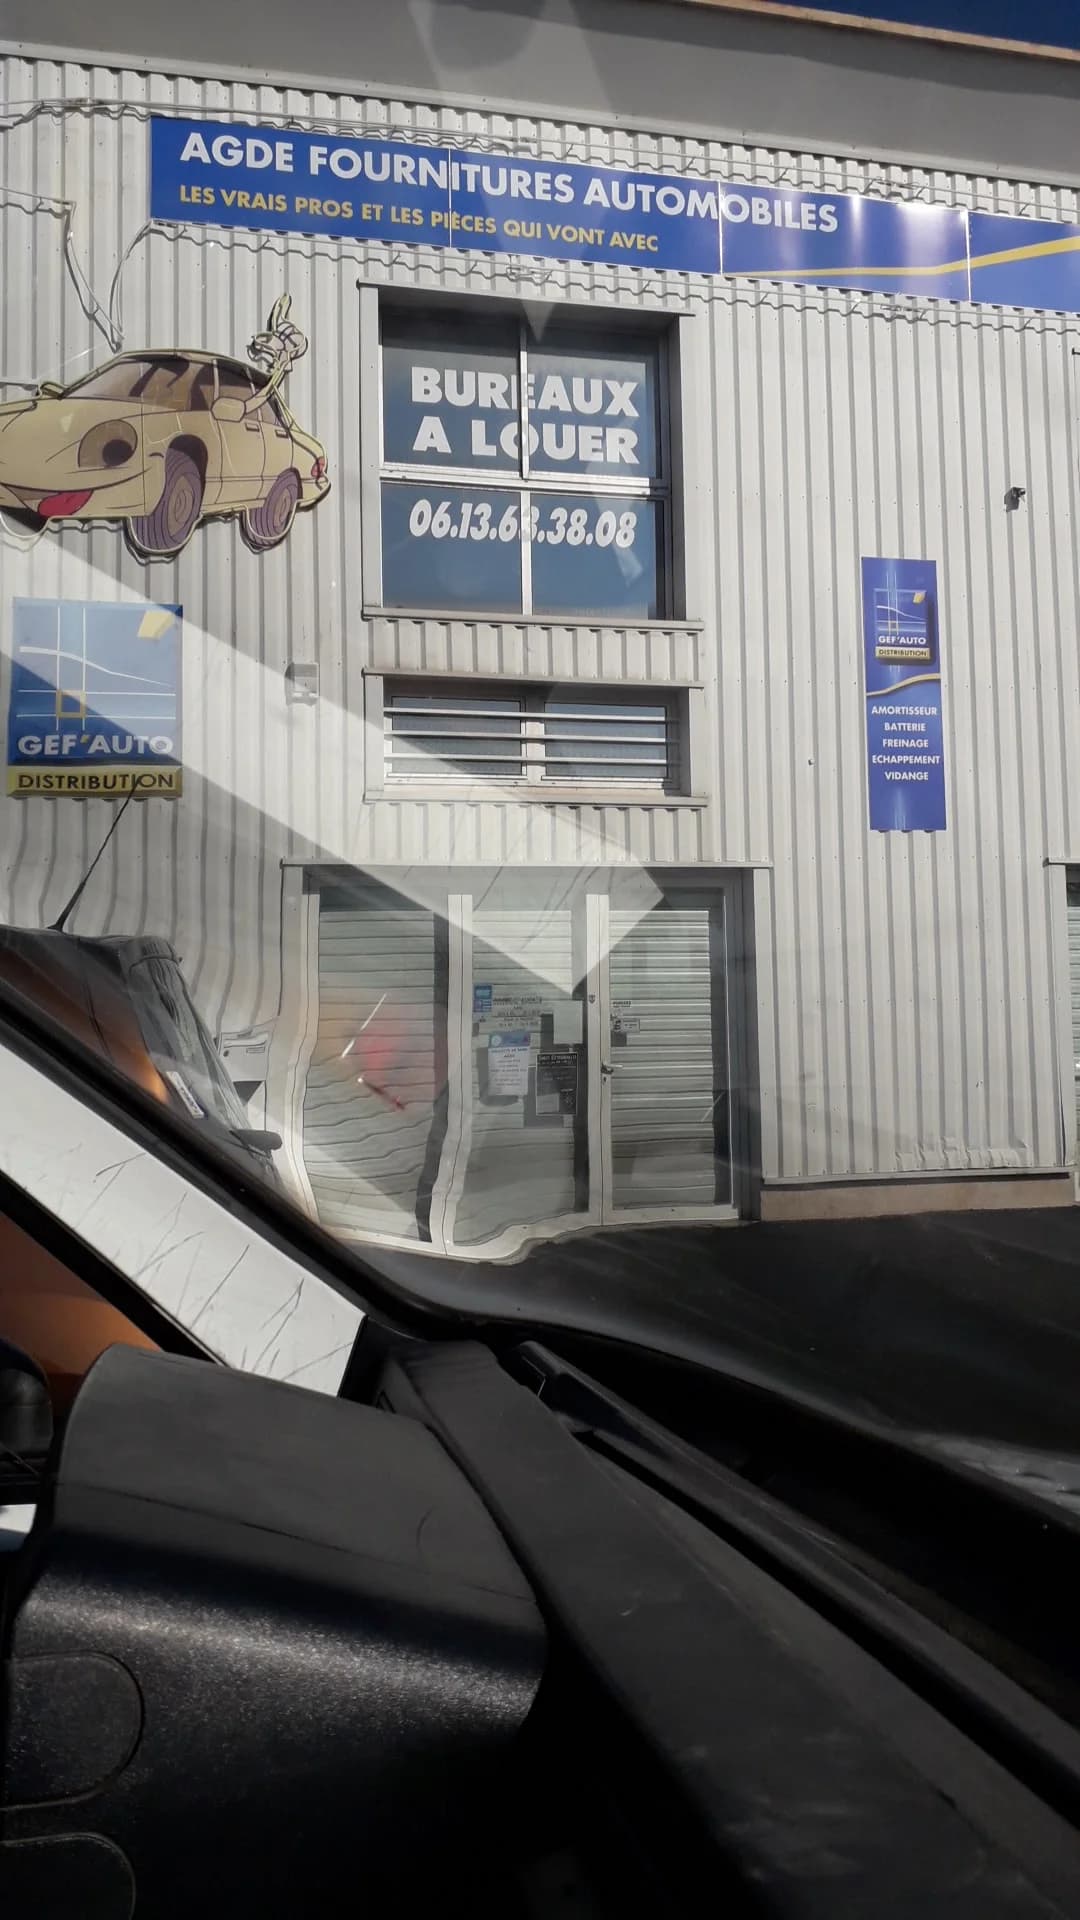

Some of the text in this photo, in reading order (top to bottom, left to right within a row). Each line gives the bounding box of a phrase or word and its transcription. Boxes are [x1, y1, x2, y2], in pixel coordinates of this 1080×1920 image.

[180, 132, 838, 232] AGDE FOURNITURES AUTOMOBILES
[180, 184, 215, 205] LES
[220, 189, 287, 212] VRAIS
[295, 196, 353, 218] PROS
[362, 204, 383, 221] ET
[391, 206, 424, 226] LES
[503, 218, 541, 239] QUI
[546, 224, 605, 246] VONT
[609, 232, 658, 252] AVEC
[411, 366, 640, 417] BUREAUX
[412, 415, 640, 465] A LOUER
[878, 649, 928, 657] DISTRIBUTION
[871, 706, 938, 716] AMORTISSEUR
[884, 722, 926, 732] BATTERIE
[882, 738, 929, 748] FREINAGE
[872, 755, 941, 765] ECHAPPEMENT
[884, 771, 929, 781] VIDANGE
[18, 774, 173, 790] DISTRIBUTION
